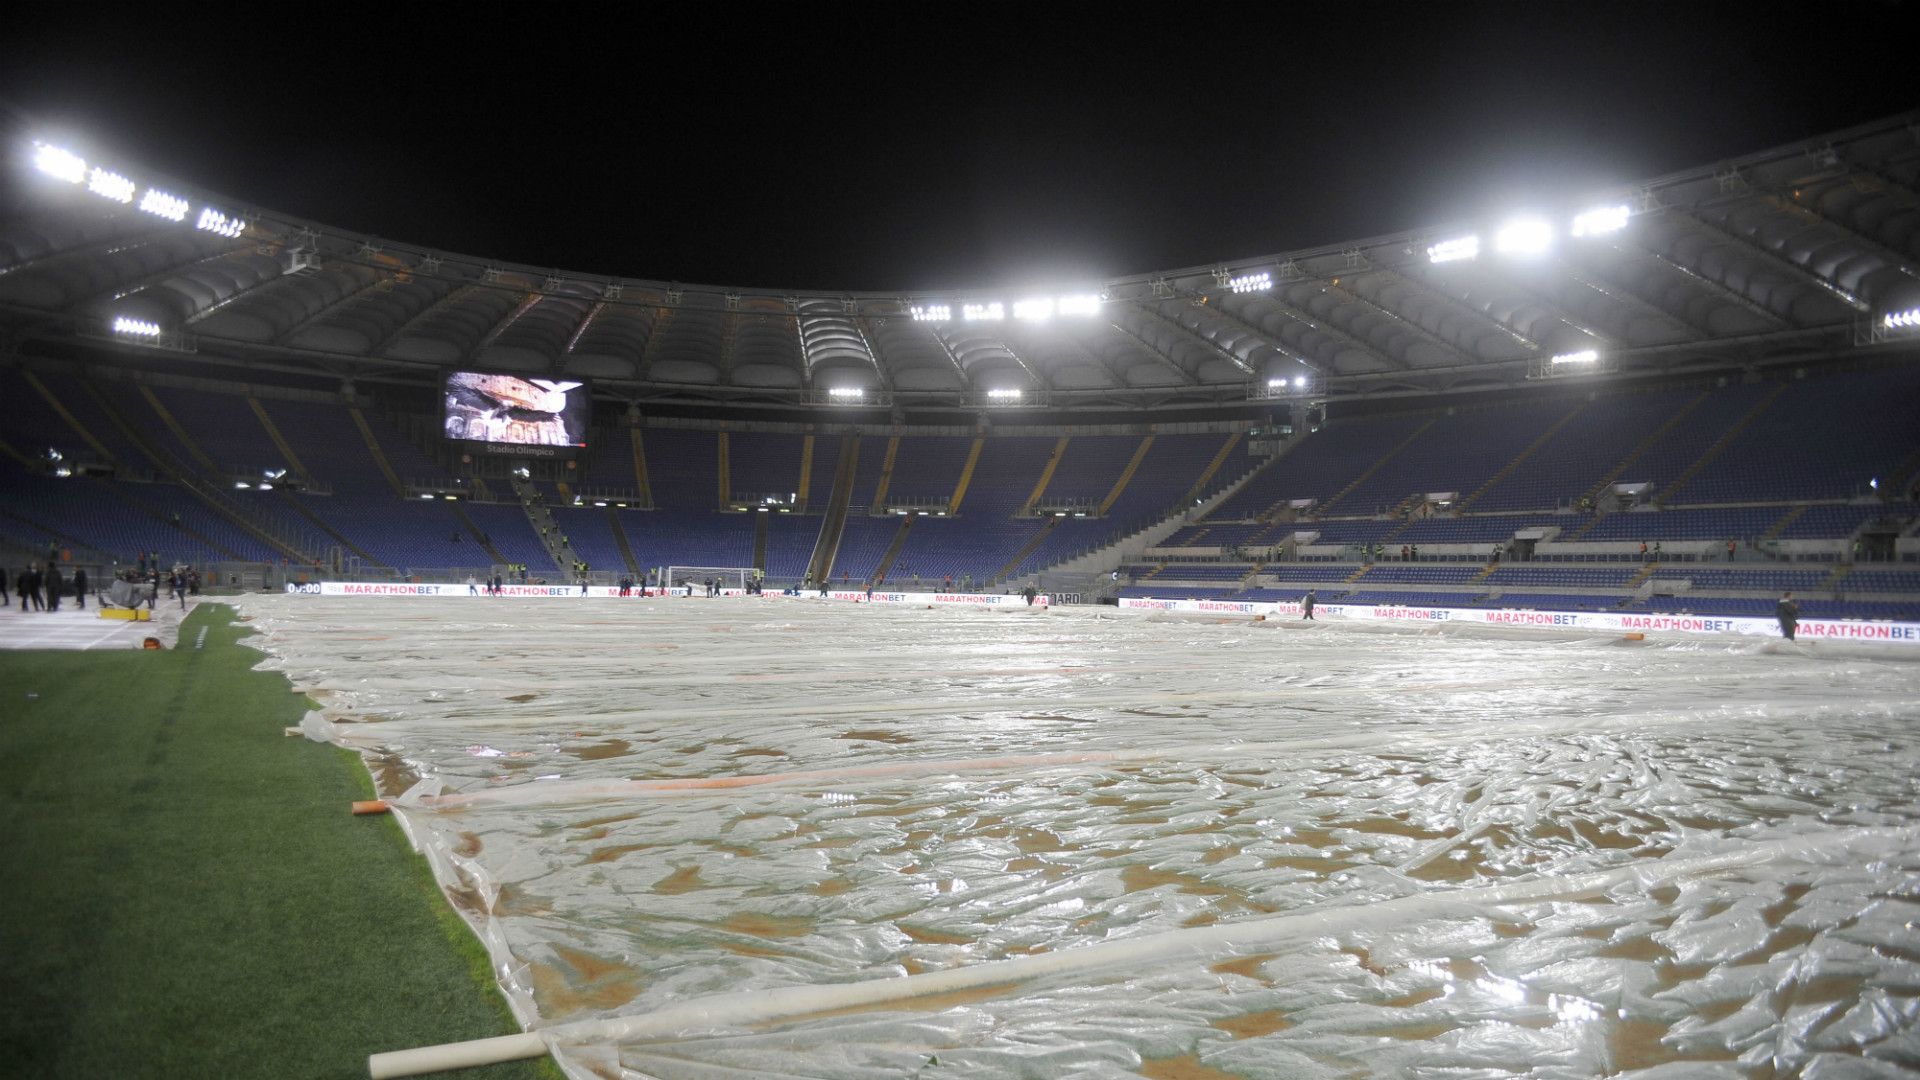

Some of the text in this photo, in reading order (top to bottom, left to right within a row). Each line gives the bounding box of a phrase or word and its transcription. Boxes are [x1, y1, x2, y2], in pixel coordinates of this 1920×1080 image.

[487, 445, 554, 456] Stadio Olimpico
[344, 585, 440, 594] MARATHONBET
[482, 587, 570, 596] MRATHONBET
[936, 595, 1002, 604] MARATHONBET
[1129, 601, 1177, 609] MARATHONBET
[1198, 603, 1254, 612] MARATHONBET
[1279, 605, 1344, 615] MARAONBET
[1374, 608, 1450, 620] MARATHONBET
[1486, 611, 1577, 625] MARATHONBET
[1621, 616, 1733, 631] MARATHONBET
